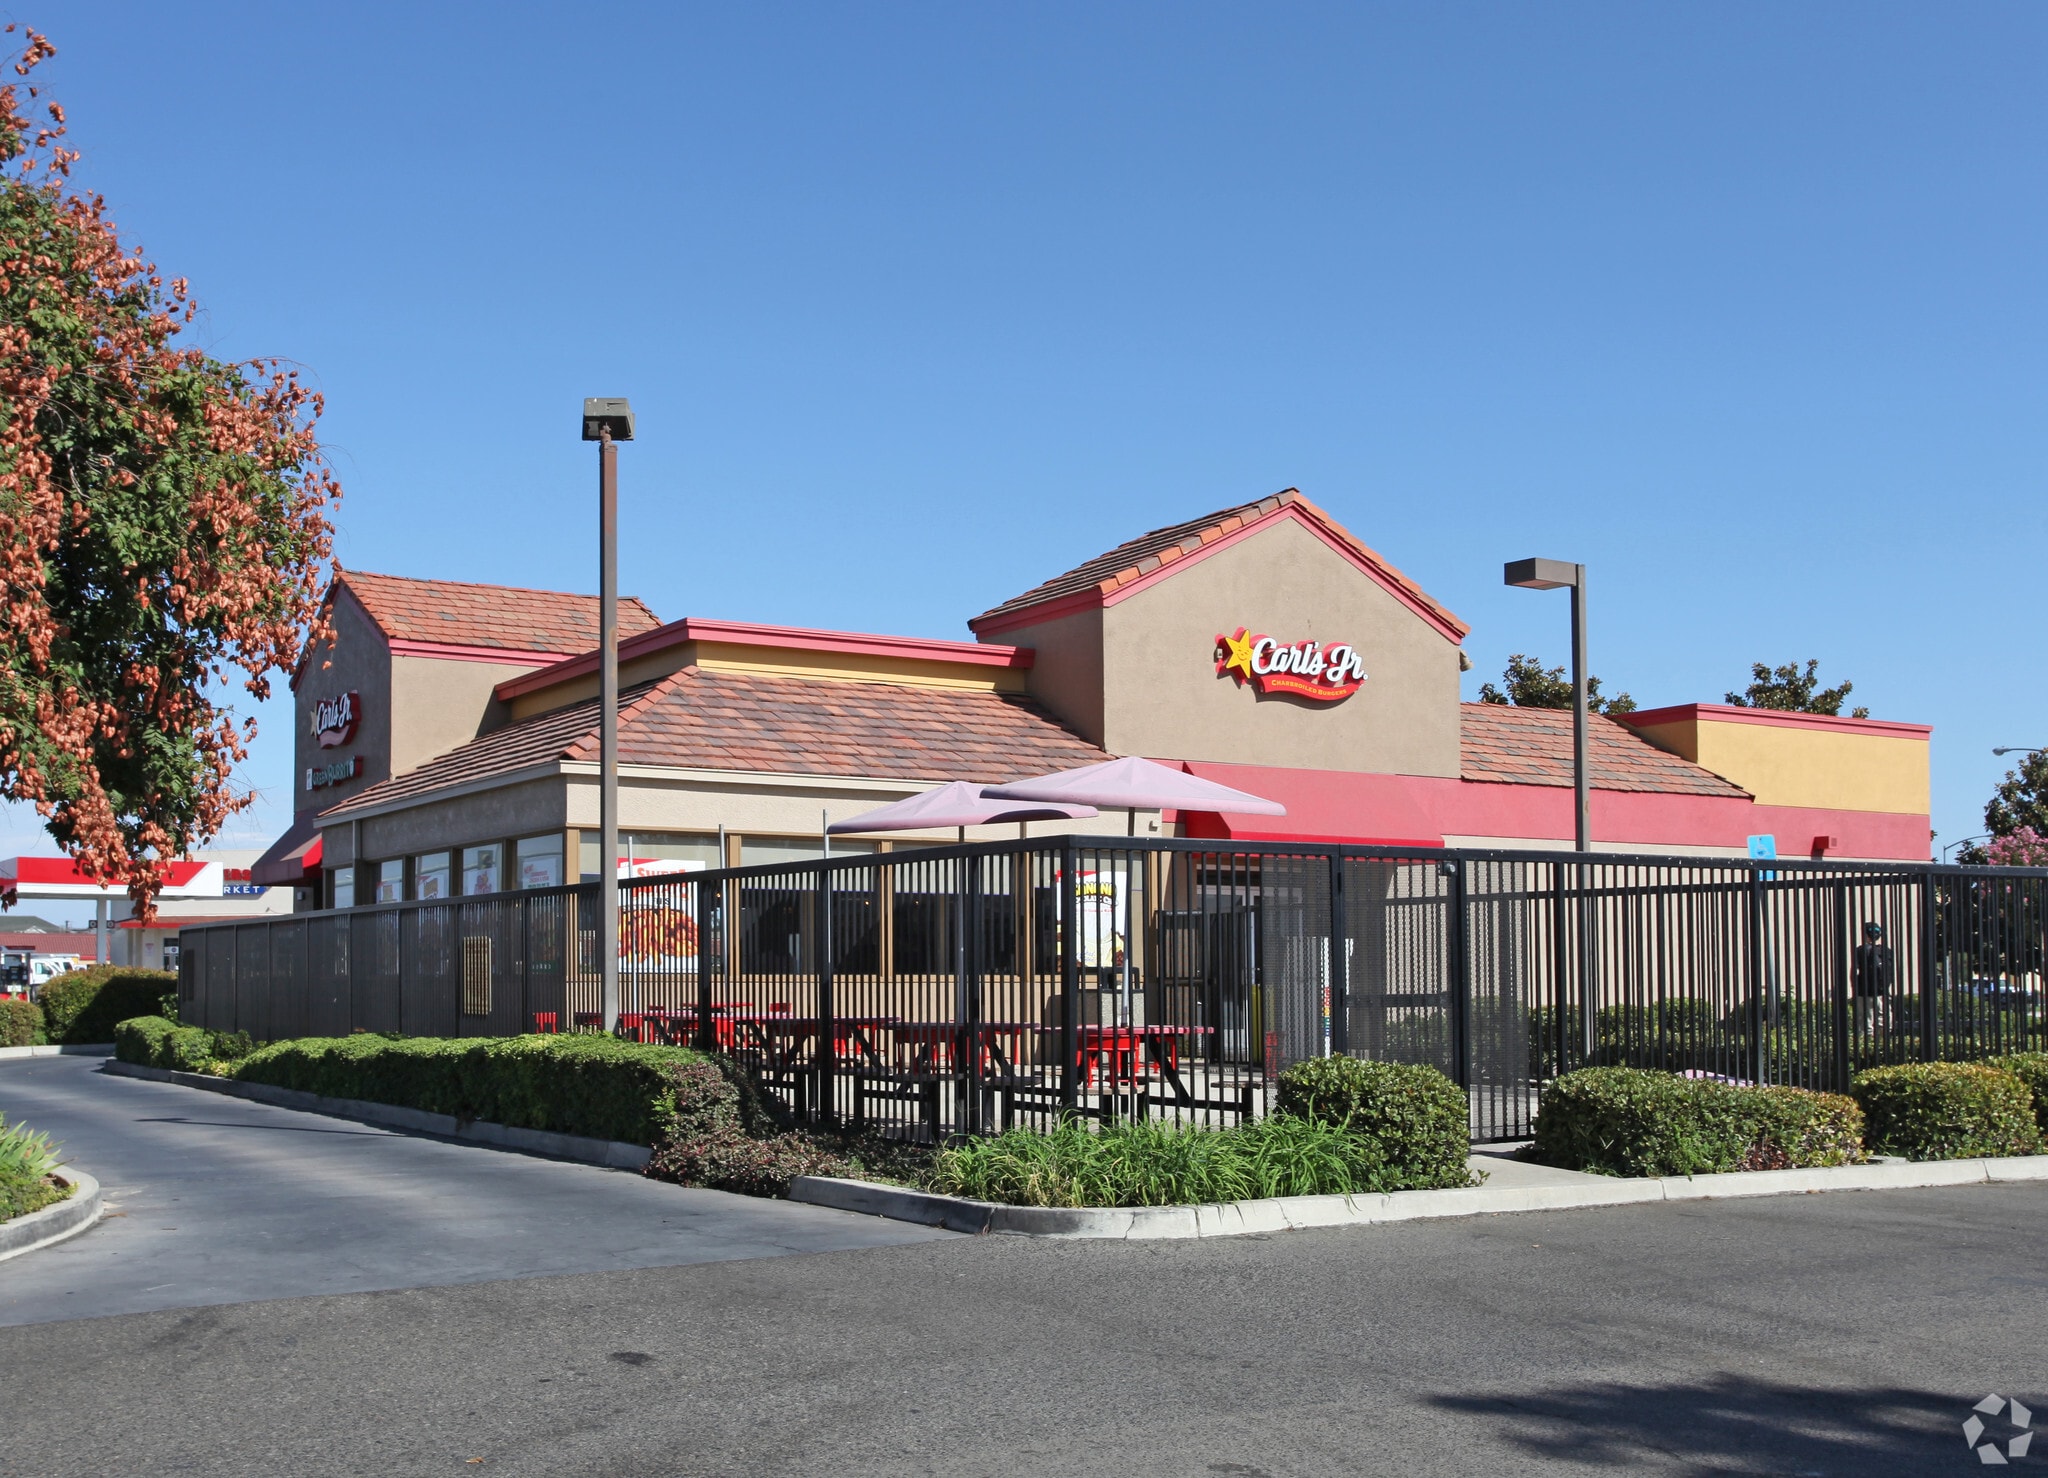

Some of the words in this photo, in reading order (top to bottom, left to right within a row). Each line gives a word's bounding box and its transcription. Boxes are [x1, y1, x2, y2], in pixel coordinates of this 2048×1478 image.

[1251, 637, 1327, 675] Carl's
[1326, 645, 1369, 682] Jr.
[316, 697, 339, 735] Carl's
[338, 692, 352, 728] Jr.
